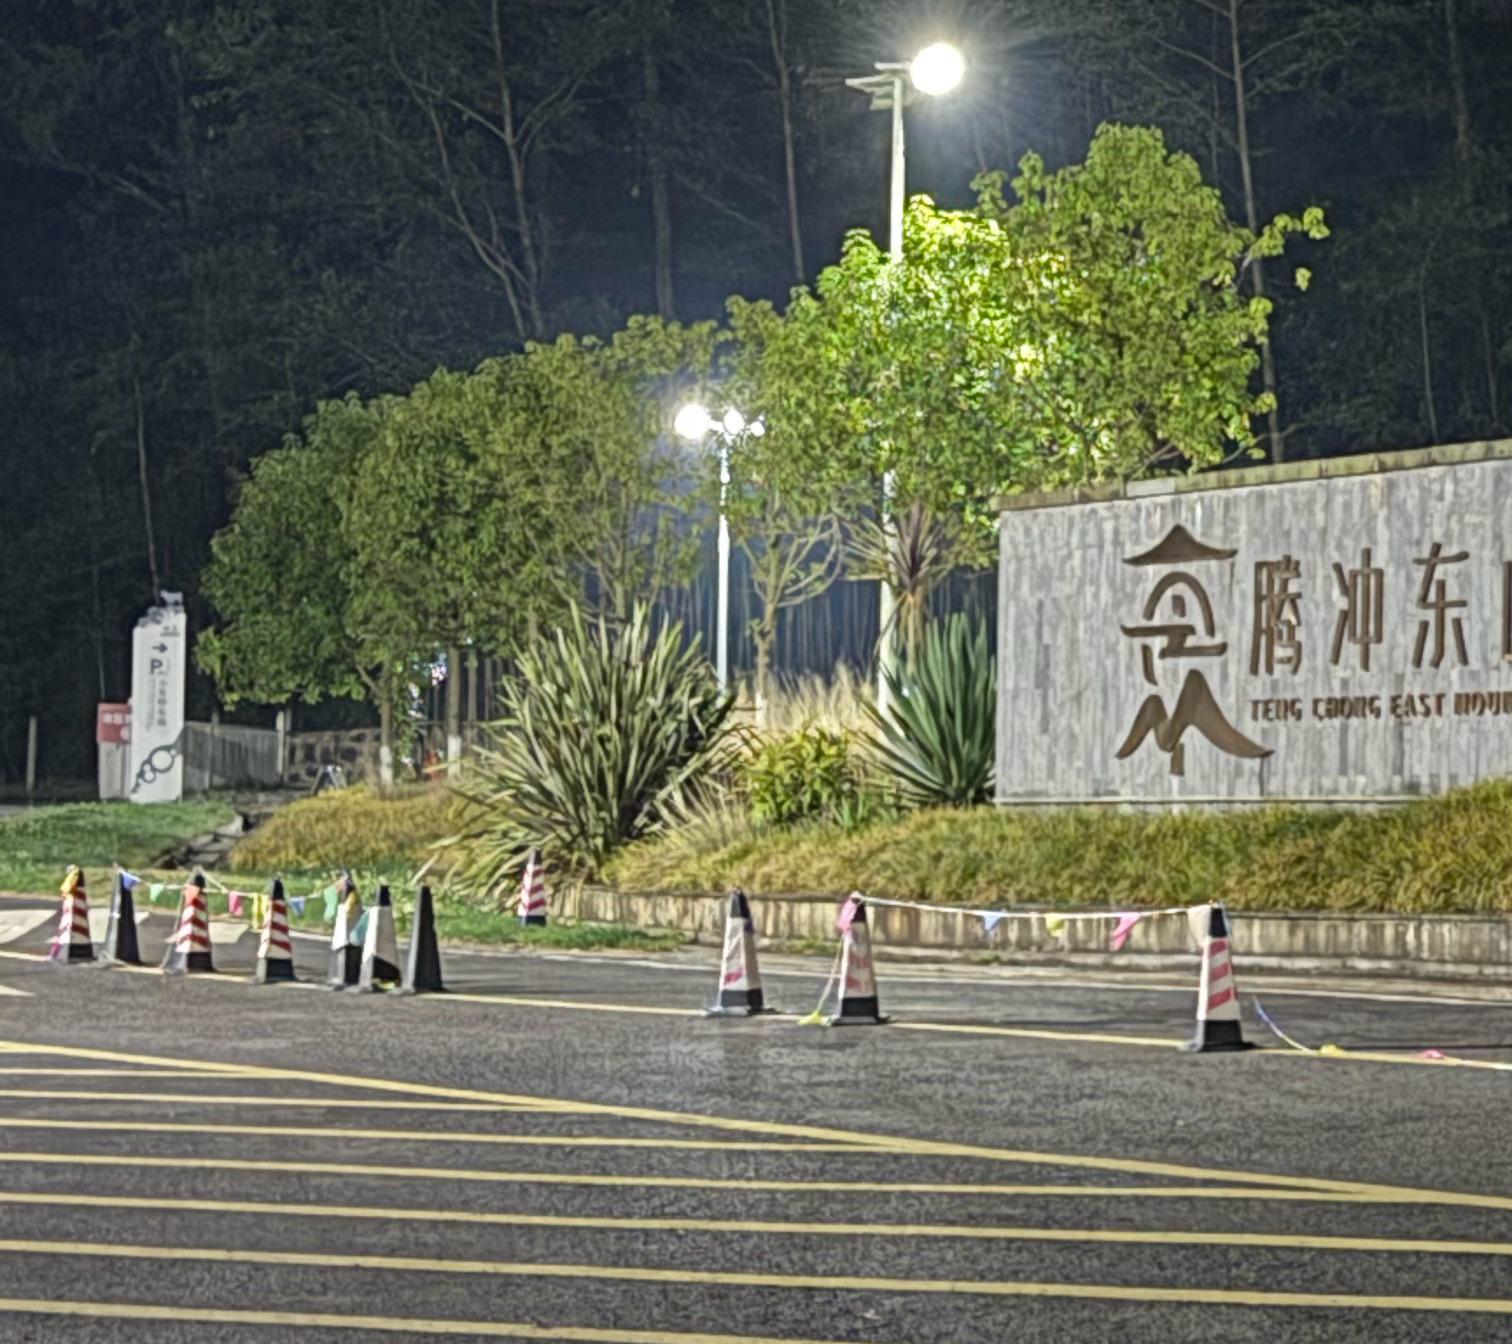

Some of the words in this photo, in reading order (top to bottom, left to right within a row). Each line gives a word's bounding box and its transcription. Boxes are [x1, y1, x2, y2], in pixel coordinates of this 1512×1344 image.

[1250, 697, 1303, 722] TENG
[1311, 693, 1382, 721] CHONG
[1390, 692, 1446, 718] EAST
